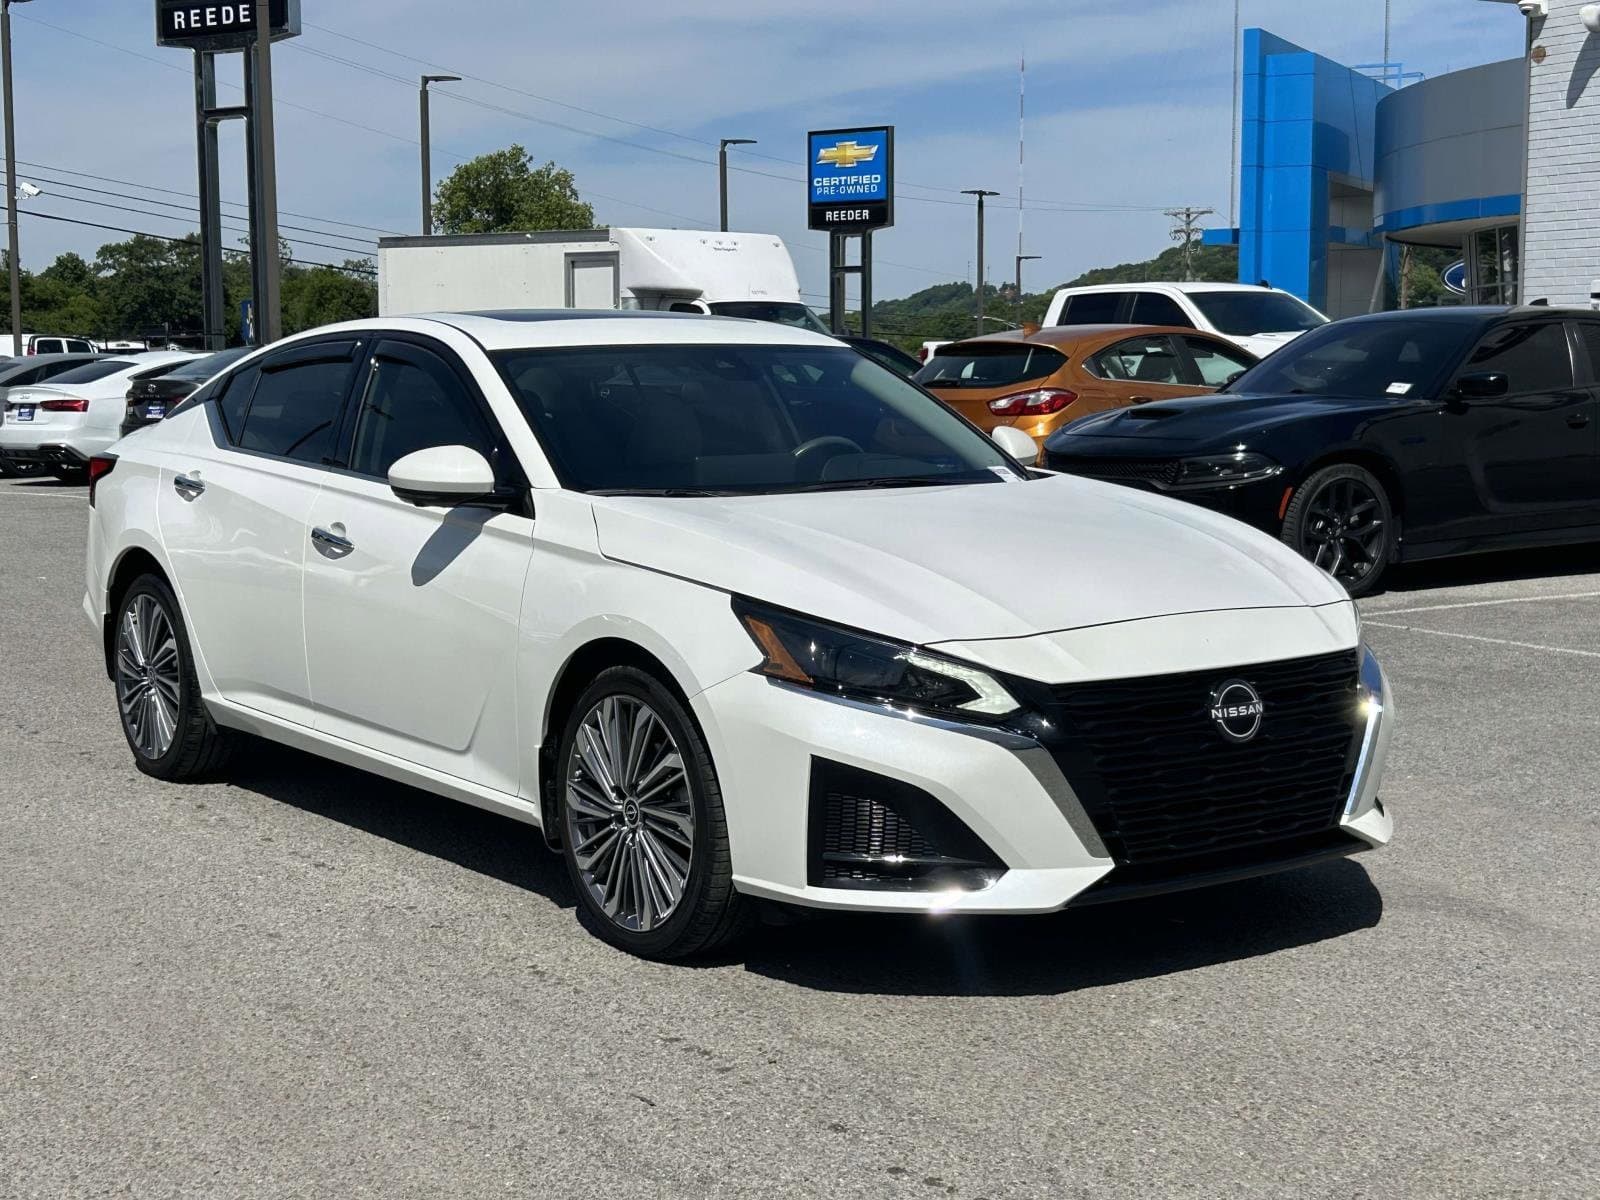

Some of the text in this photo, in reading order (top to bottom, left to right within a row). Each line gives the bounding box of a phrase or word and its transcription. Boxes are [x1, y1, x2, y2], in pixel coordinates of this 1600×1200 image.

[173, 4, 251, 30] REEDE
[813, 174, 881, 187] CERTIFIED
[816, 184, 878, 195] PRE-OWNED
[825, 209, 869, 222] REEDER
[1211, 702, 1263, 719] NISSAN
